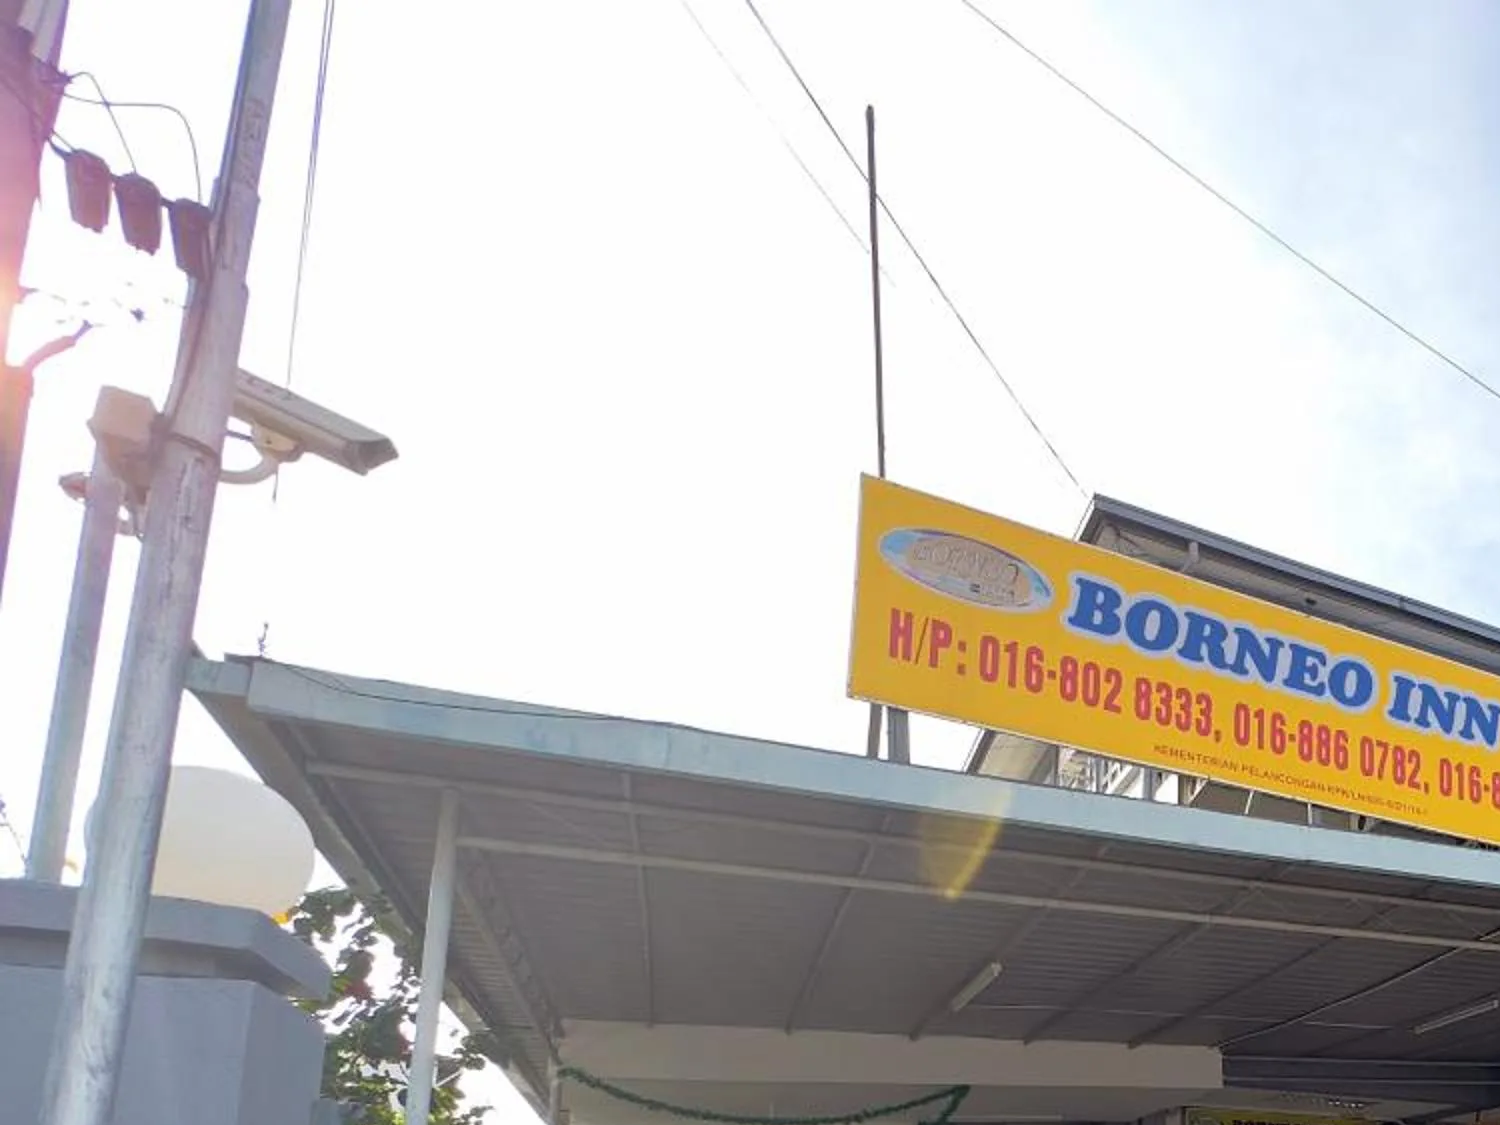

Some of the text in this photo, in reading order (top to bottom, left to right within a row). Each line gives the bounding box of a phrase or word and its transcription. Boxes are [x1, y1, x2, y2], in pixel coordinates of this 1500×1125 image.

[888, 606, 967, 676] H/P:
[979, 634, 1123, 714] 016-802
[1134, 676, 1222, 744] 8333,
[1234, 702, 1349, 771] 016-886
[1360, 736, 1429, 796] 0782,
[1066, 576, 1375, 708] BORNEO
